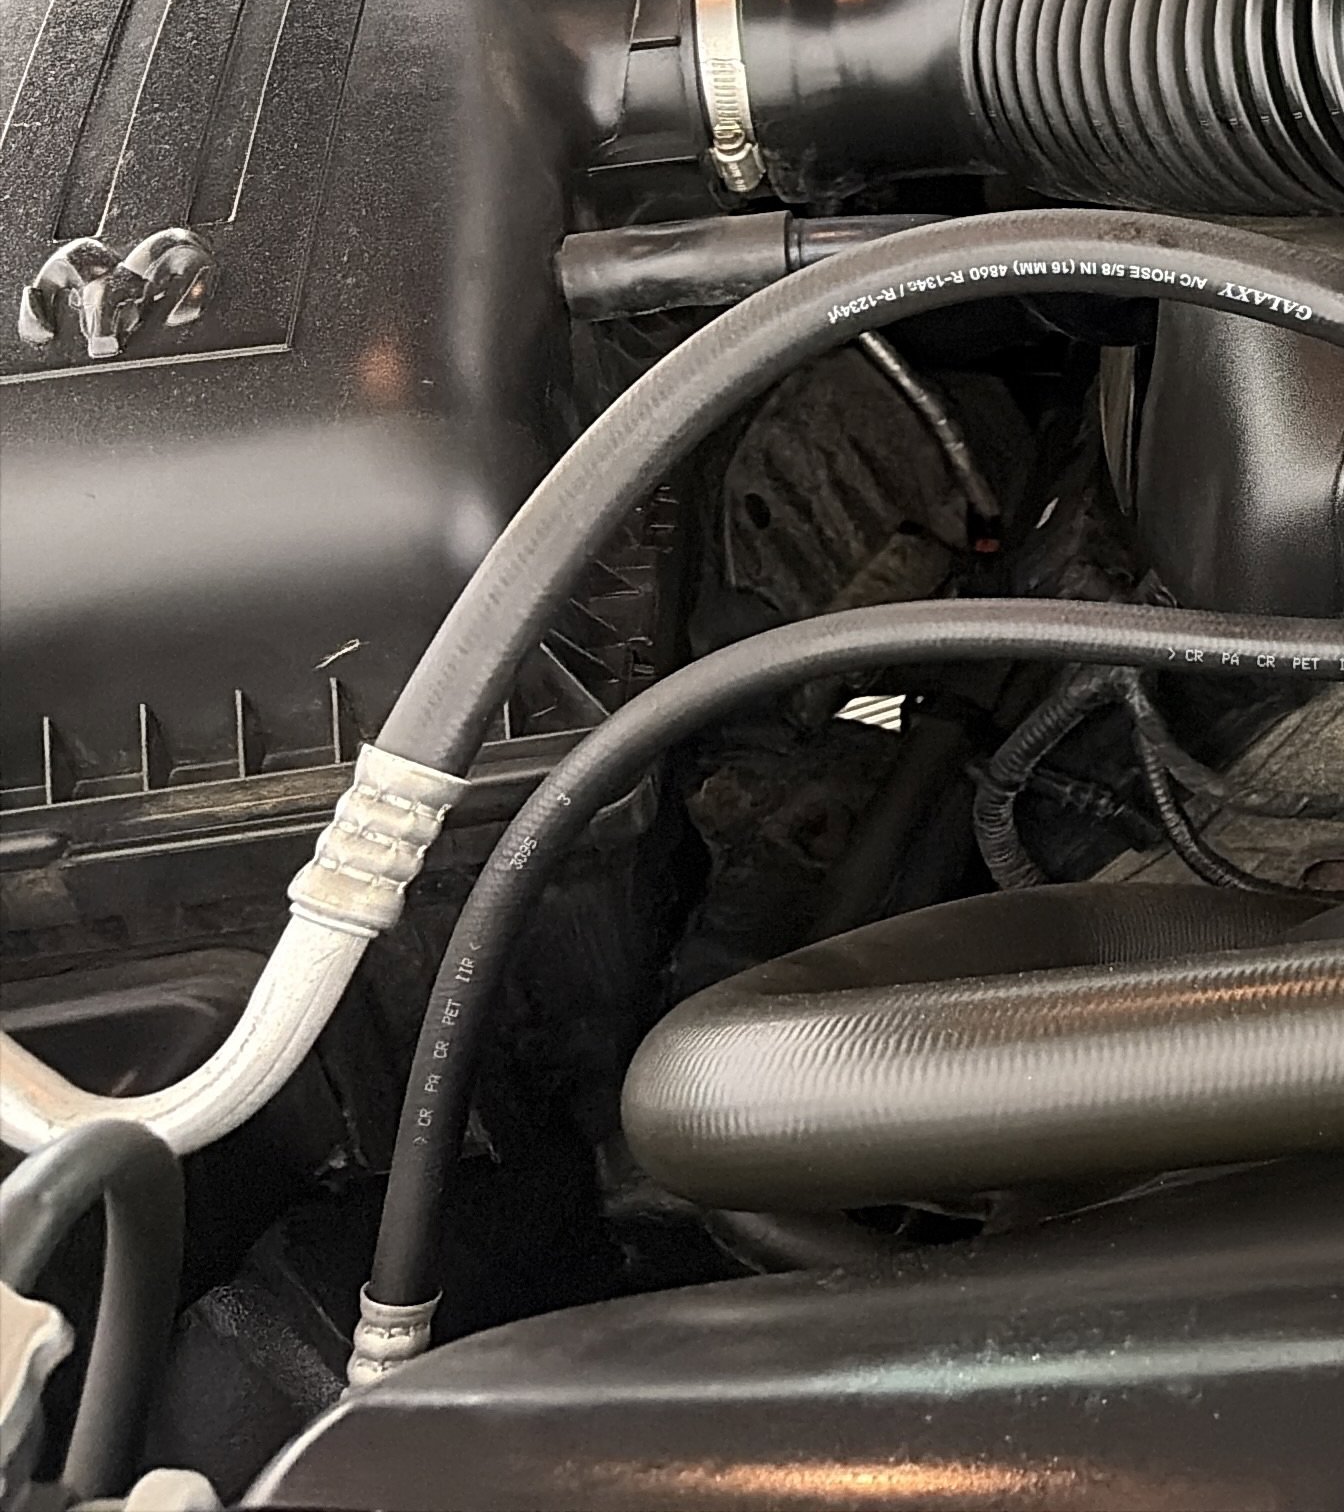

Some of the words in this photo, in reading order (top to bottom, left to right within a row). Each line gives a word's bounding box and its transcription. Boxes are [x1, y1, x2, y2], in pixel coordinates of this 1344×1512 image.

[969, 264, 1008, 281] 4860
[1012, 259, 1047, 276] MM)
[1052, 258, 1075, 275] (16
[1080, 262, 1097, 275] IN
[1101, 262, 1125, 277] 5/8
[1129, 265, 1175, 284] HOSE
[1179, 274, 1208, 289] A/C
[827, 287, 896, 324] R-1234yf
[1217, 282, 1313, 321] GALAXY
[1185, 649, 1204, 663] CR
[1221, 653, 1240, 667] PA
[1257, 654, 1276, 668] CR
[1292, 657, 1320, 671] PET
[441, 998, 462, 1026] PET
[433, 1040, 450, 1059] CR
[424, 1073, 442, 1093] PA
[417, 1108, 434, 1127] CR
